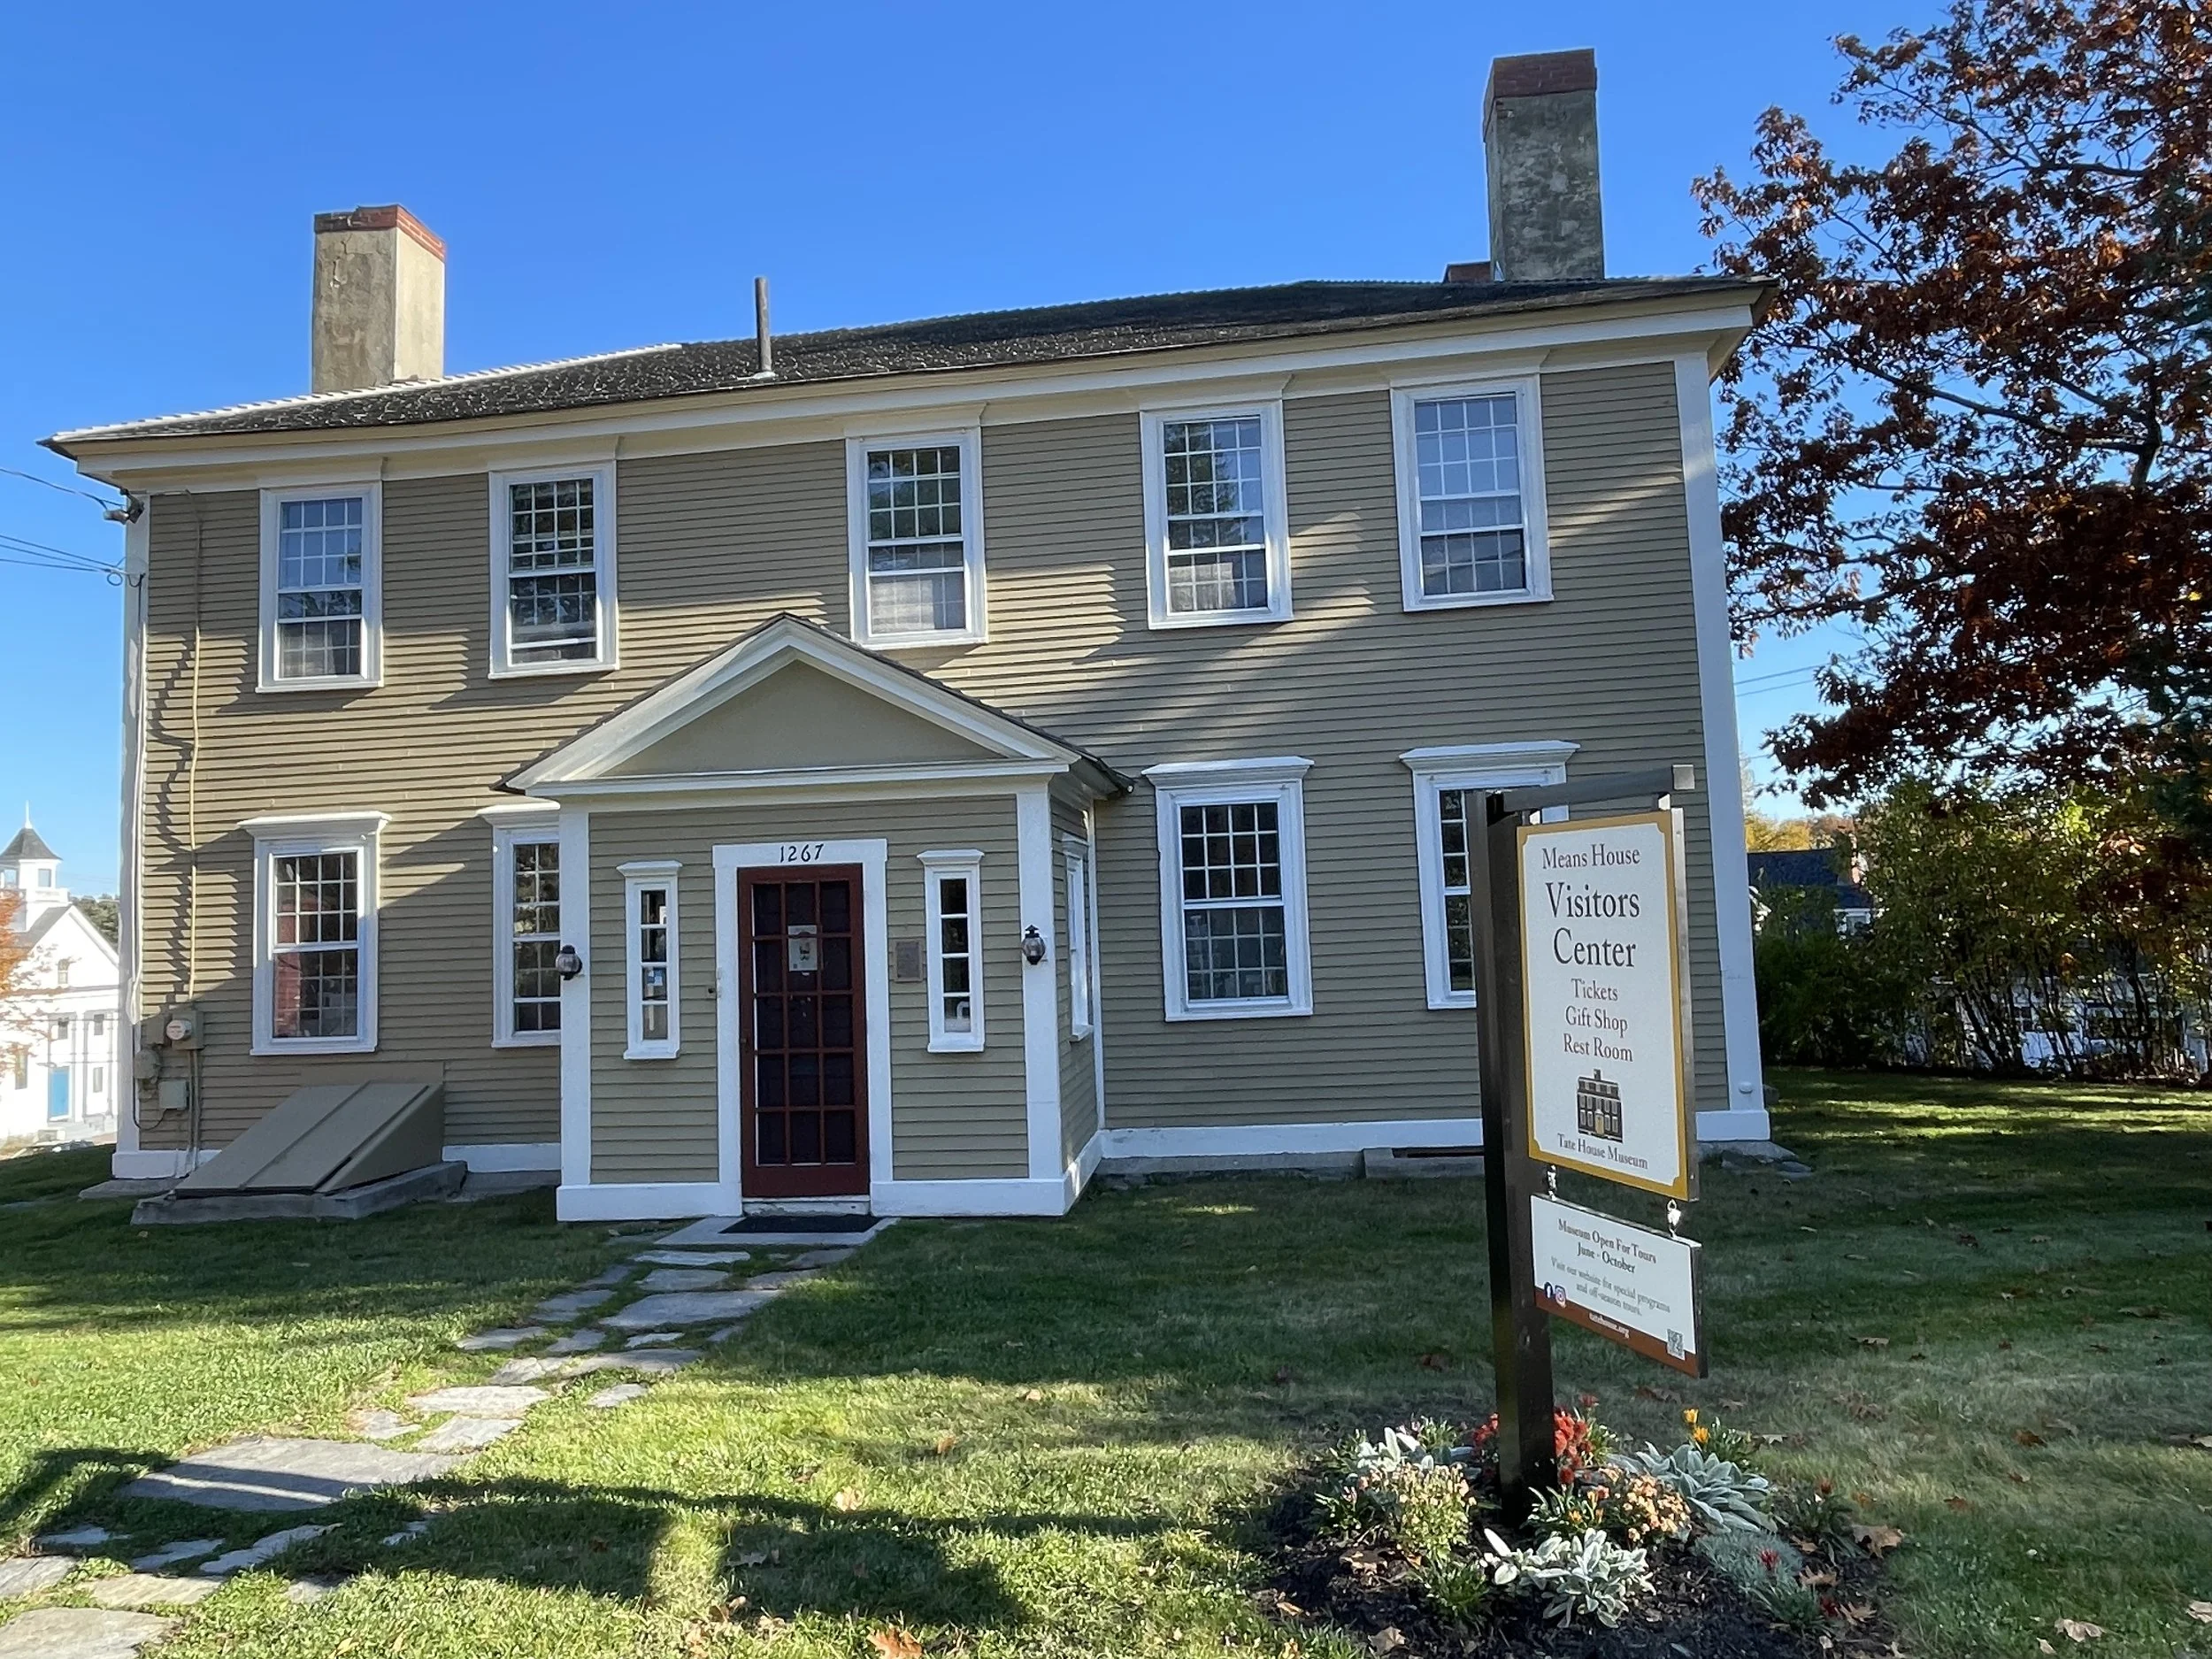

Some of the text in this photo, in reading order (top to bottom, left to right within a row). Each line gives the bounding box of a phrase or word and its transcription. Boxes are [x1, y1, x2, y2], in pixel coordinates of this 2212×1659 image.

[780, 843, 825, 864] 1267
[1542, 843, 1640, 870] Means House
[1545, 881, 1640, 918] Visitors
[1553, 926, 1637, 967] Center
[1571, 978, 1619, 1002] Tickets
[1565, 1005, 1628, 1038] Gift Shop
[1563, 1033, 1633, 1063] Rest Room
[1557, 1133, 1648, 1169] Tate House Museum
[1558, 1217, 1657, 1263] Museum Open For Tours
[1577, 1241, 1595, 1259] June
[1602, 1250, 1636, 1274] October
[1613, 1282, 1636, 1299] special
[1637, 1293, 1671, 1314] programs
